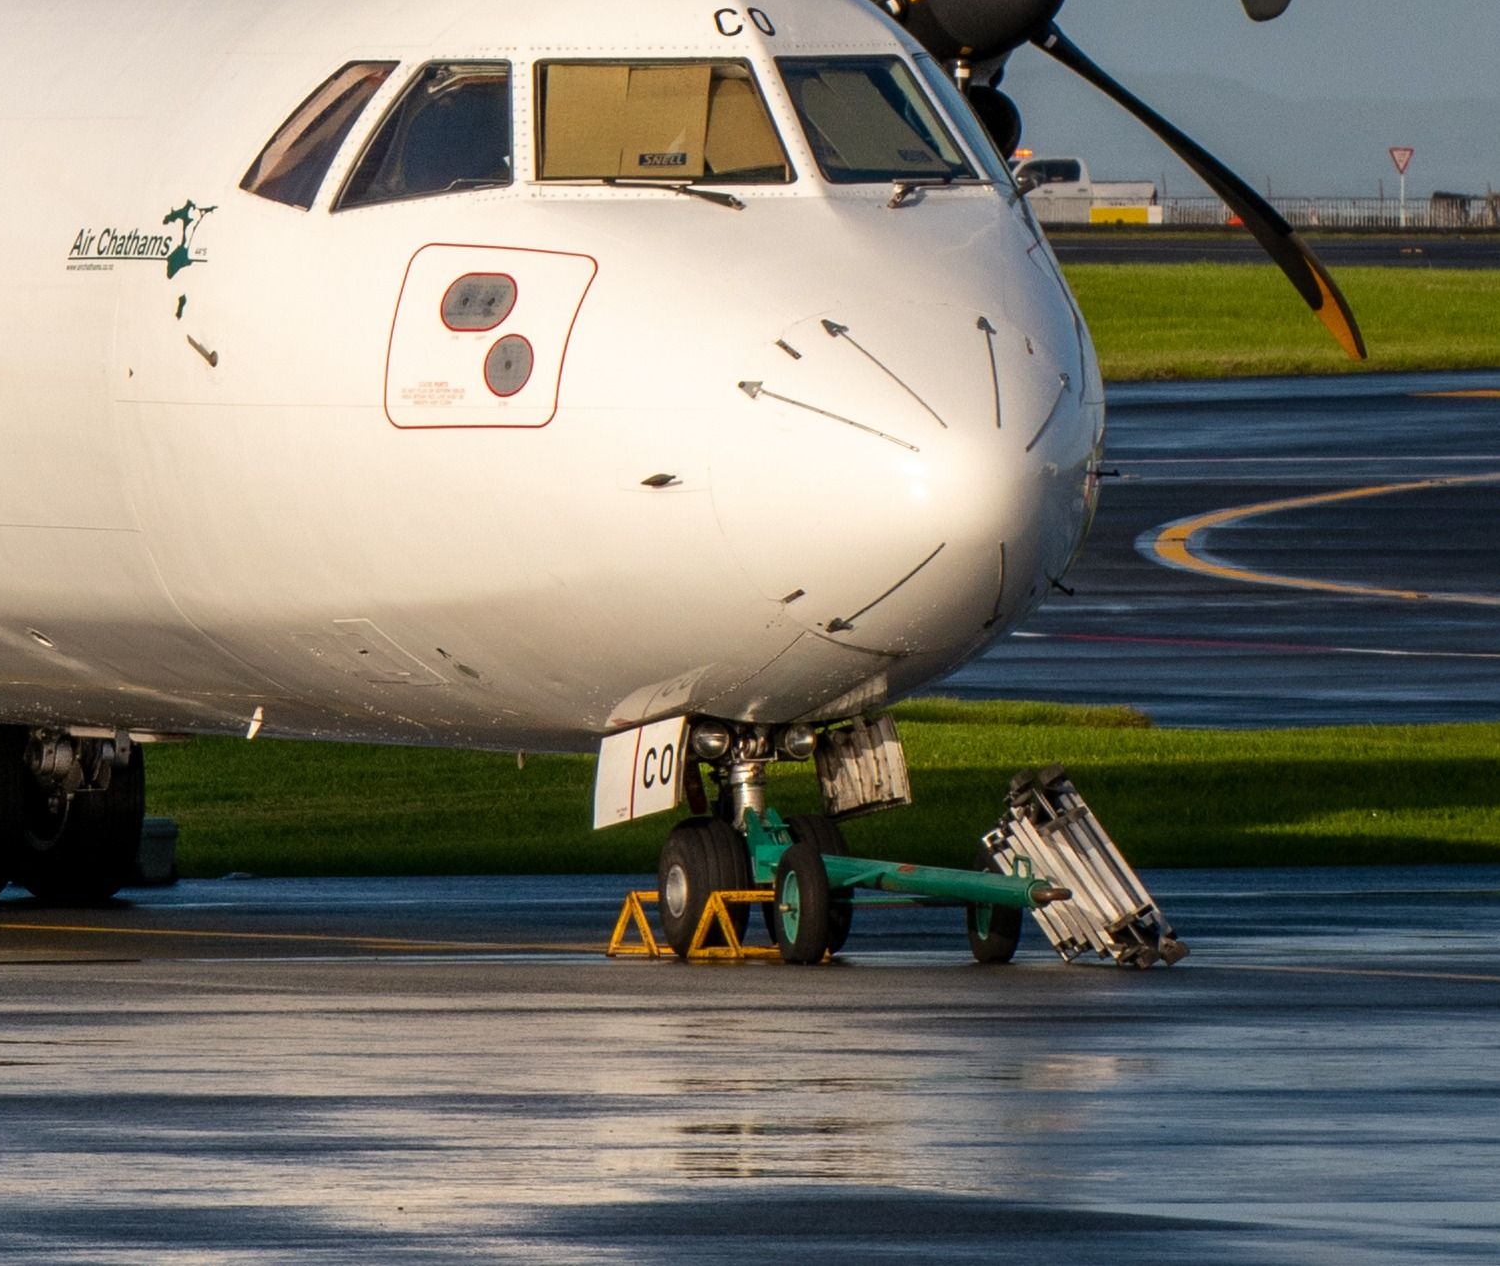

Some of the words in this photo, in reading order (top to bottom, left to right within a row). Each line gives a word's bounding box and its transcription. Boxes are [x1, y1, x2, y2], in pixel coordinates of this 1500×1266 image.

[713, 7, 776, 36] CO
[69, 228, 95, 256] Air
[97, 227, 173, 256] Chathams
[643, 743, 674, 789] CO
